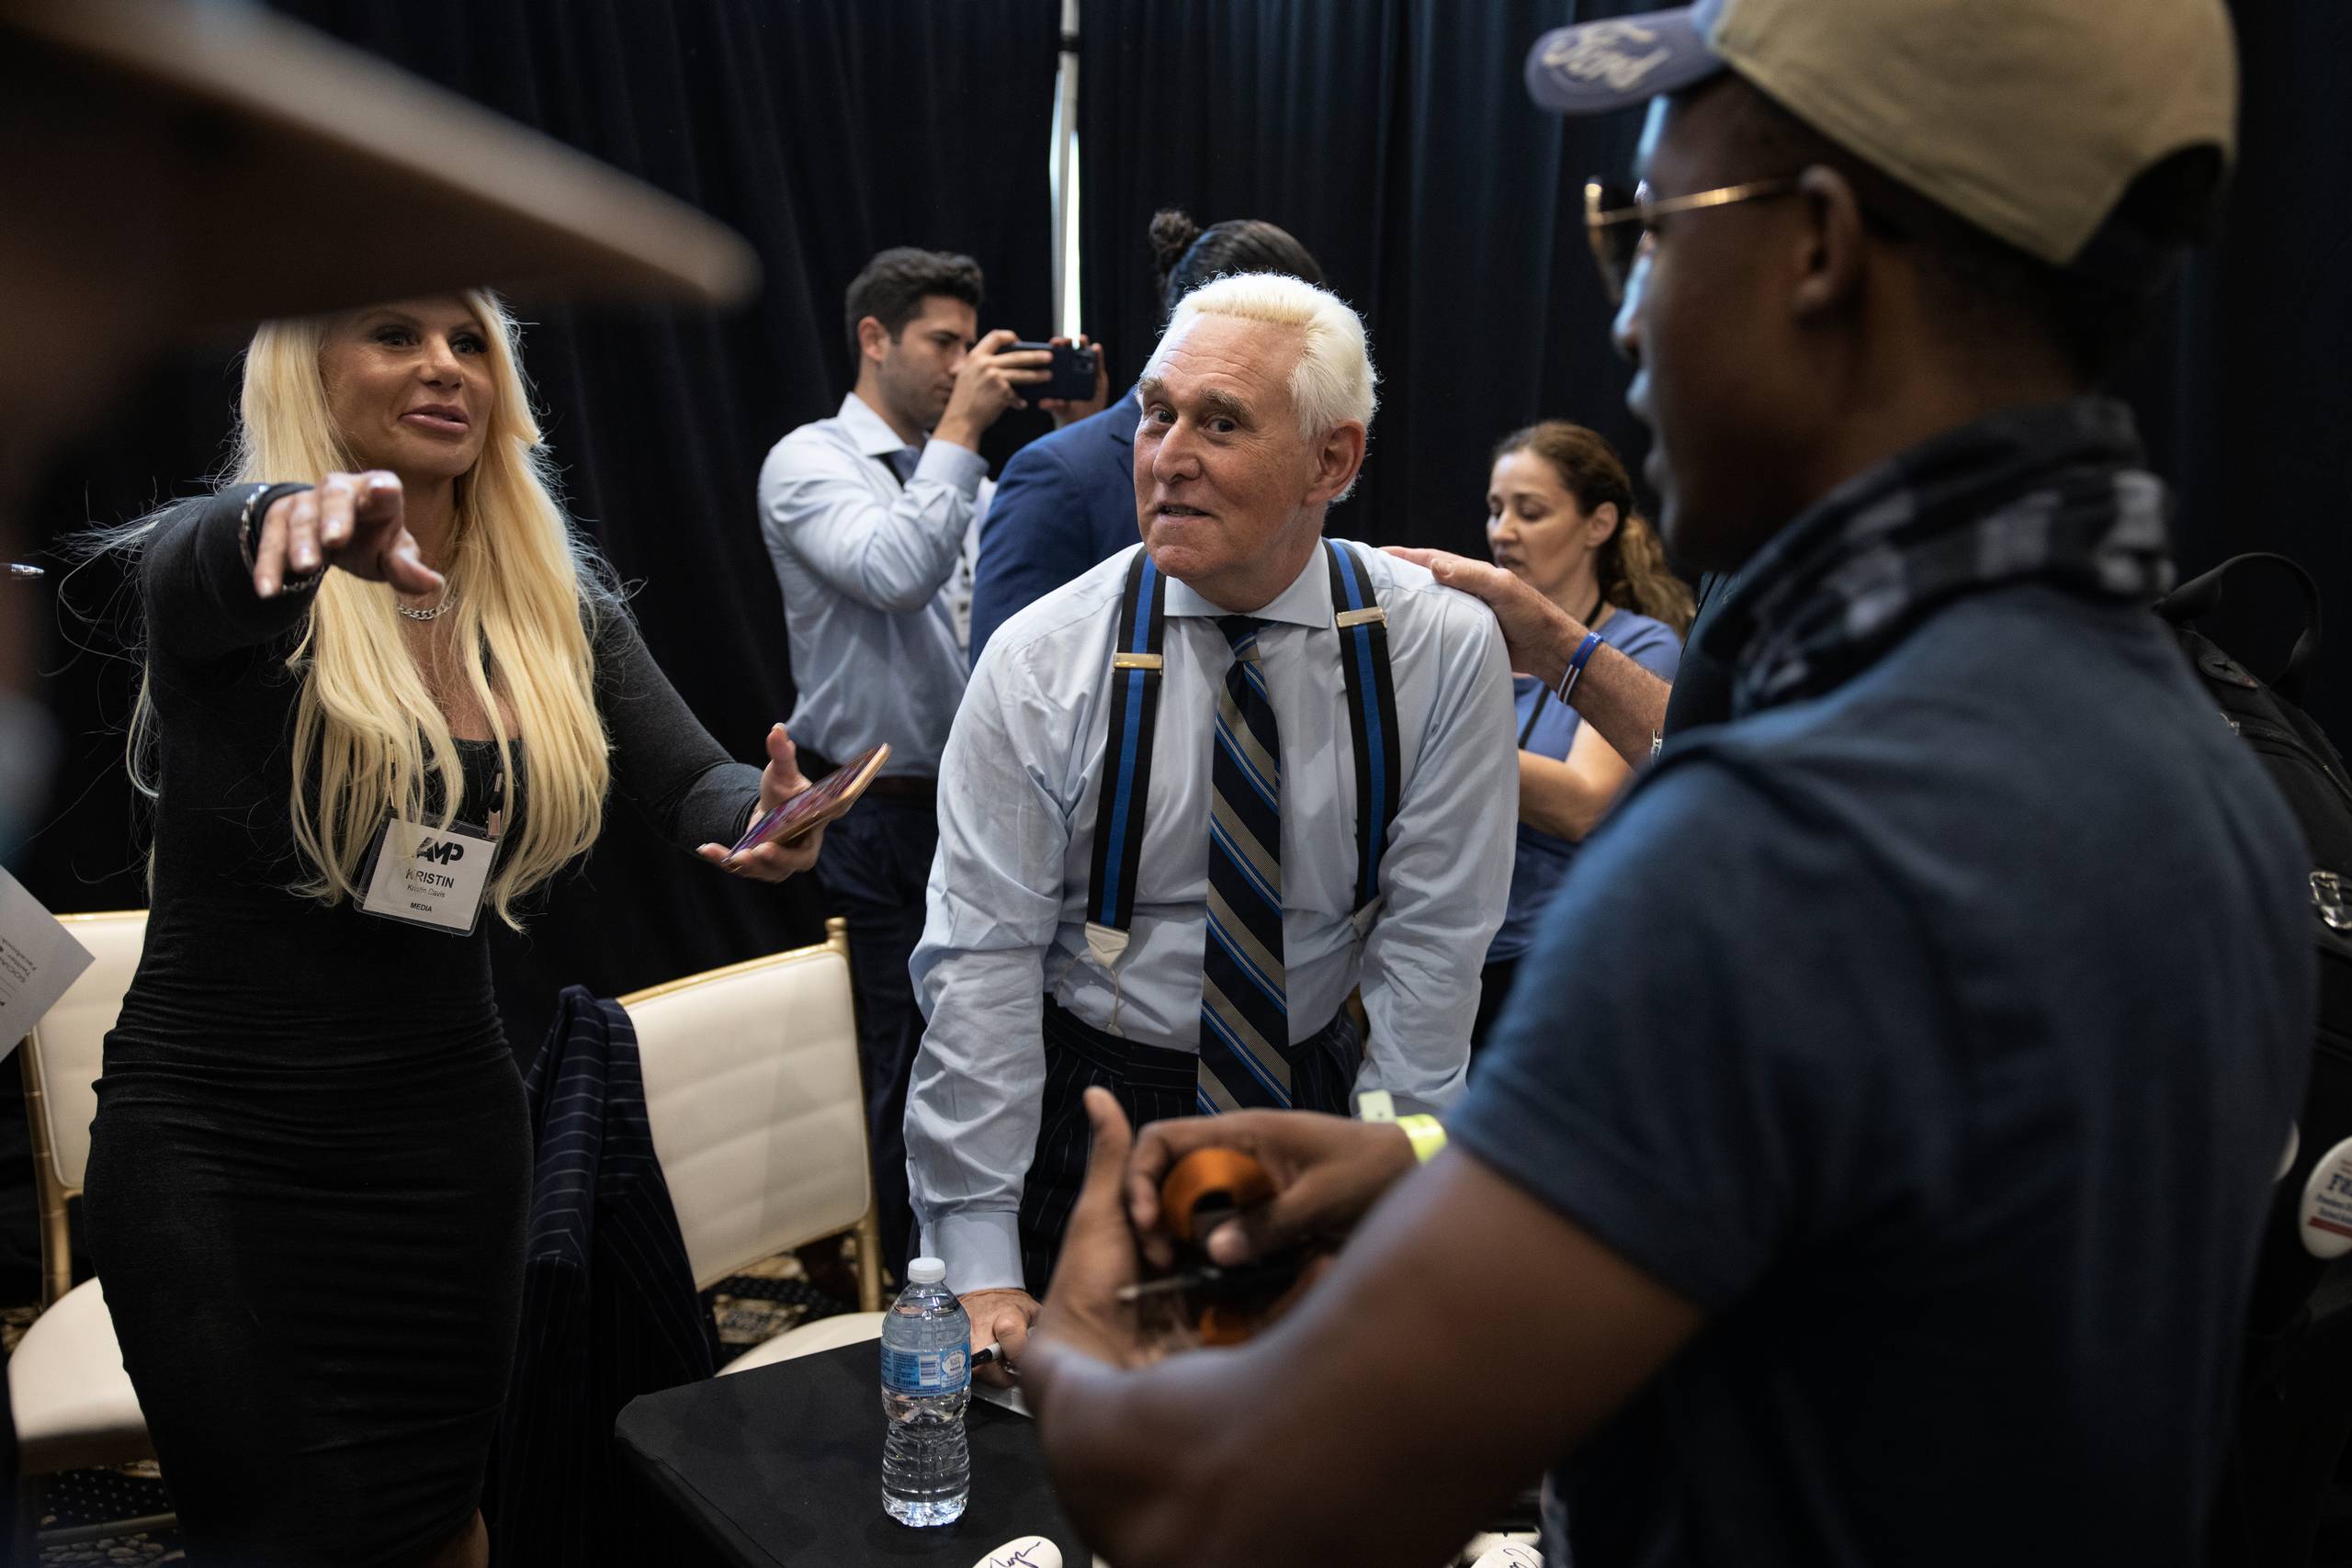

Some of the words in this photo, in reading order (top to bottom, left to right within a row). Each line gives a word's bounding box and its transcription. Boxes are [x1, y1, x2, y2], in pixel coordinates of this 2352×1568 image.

[414, 837, 464, 865] AMP
[405, 868, 454, 888] KRISTIN
[410, 902, 432, 912] MEDIA
